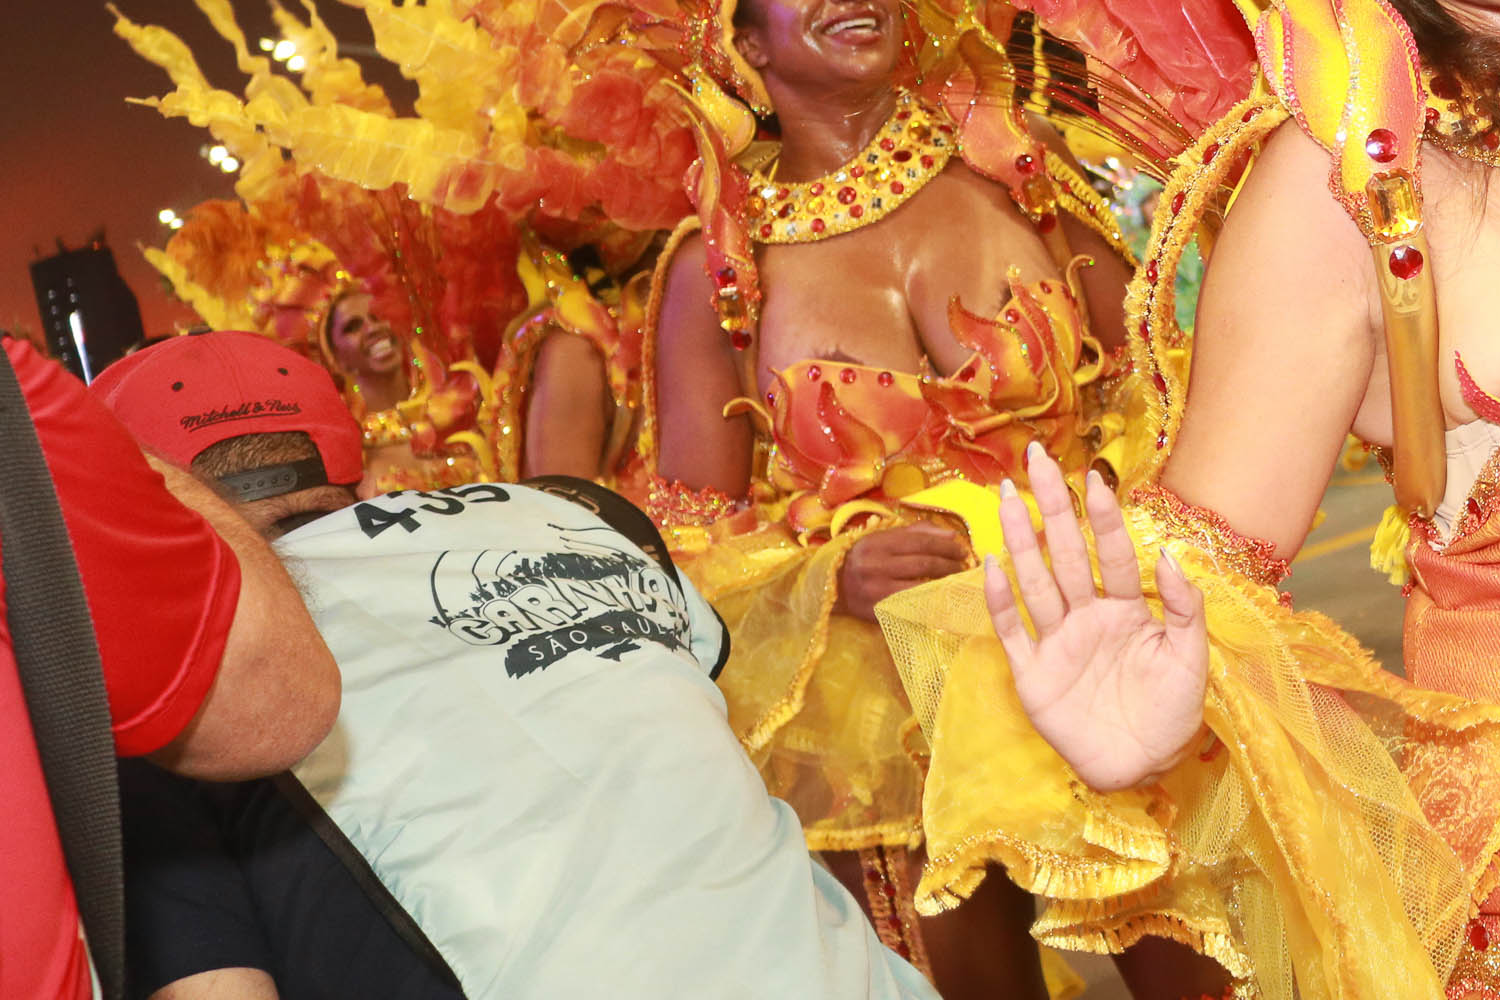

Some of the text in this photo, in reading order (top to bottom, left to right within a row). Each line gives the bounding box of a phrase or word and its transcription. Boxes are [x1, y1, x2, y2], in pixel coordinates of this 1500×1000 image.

[180, 399, 302, 429] Mitchell & Ness
[527, 629, 588, 661] SÃO
